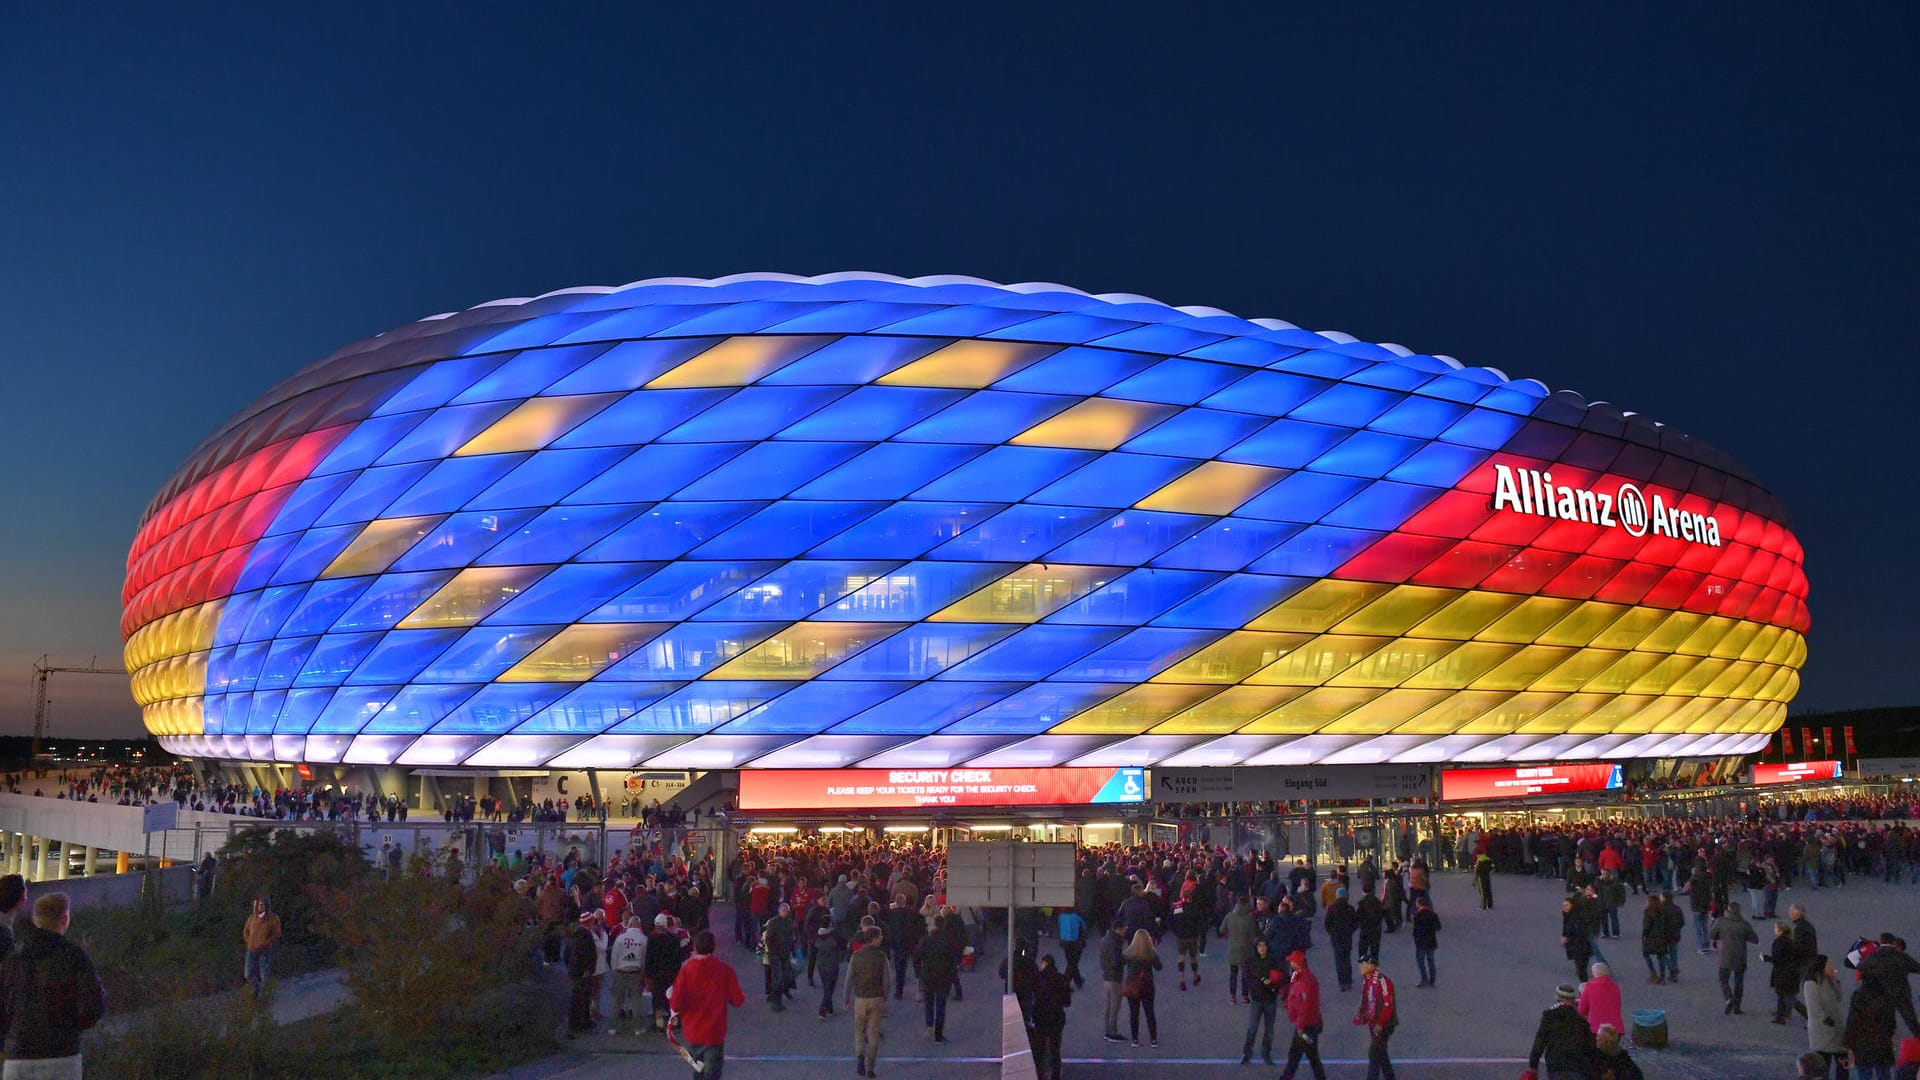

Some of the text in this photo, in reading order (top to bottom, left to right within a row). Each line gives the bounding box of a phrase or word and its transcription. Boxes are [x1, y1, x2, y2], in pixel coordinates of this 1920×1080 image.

[1494, 464, 1721, 546] Allianz Arena
[888, 770, 992, 783] SECURITY CHECK
[557, 776, 568, 795] C
[827, 787, 855, 795] PLEASE
[856, 787, 874, 795] KEEP
[897, 786, 925, 794] TICKETS
[926, 786, 949, 794] READY
[965, 785, 978, 793] THE
[980, 785, 1013, 793] SECURITY
[1285, 777, 1327, 790] Eingang Süd
[914, 796, 938, 804] THANK
